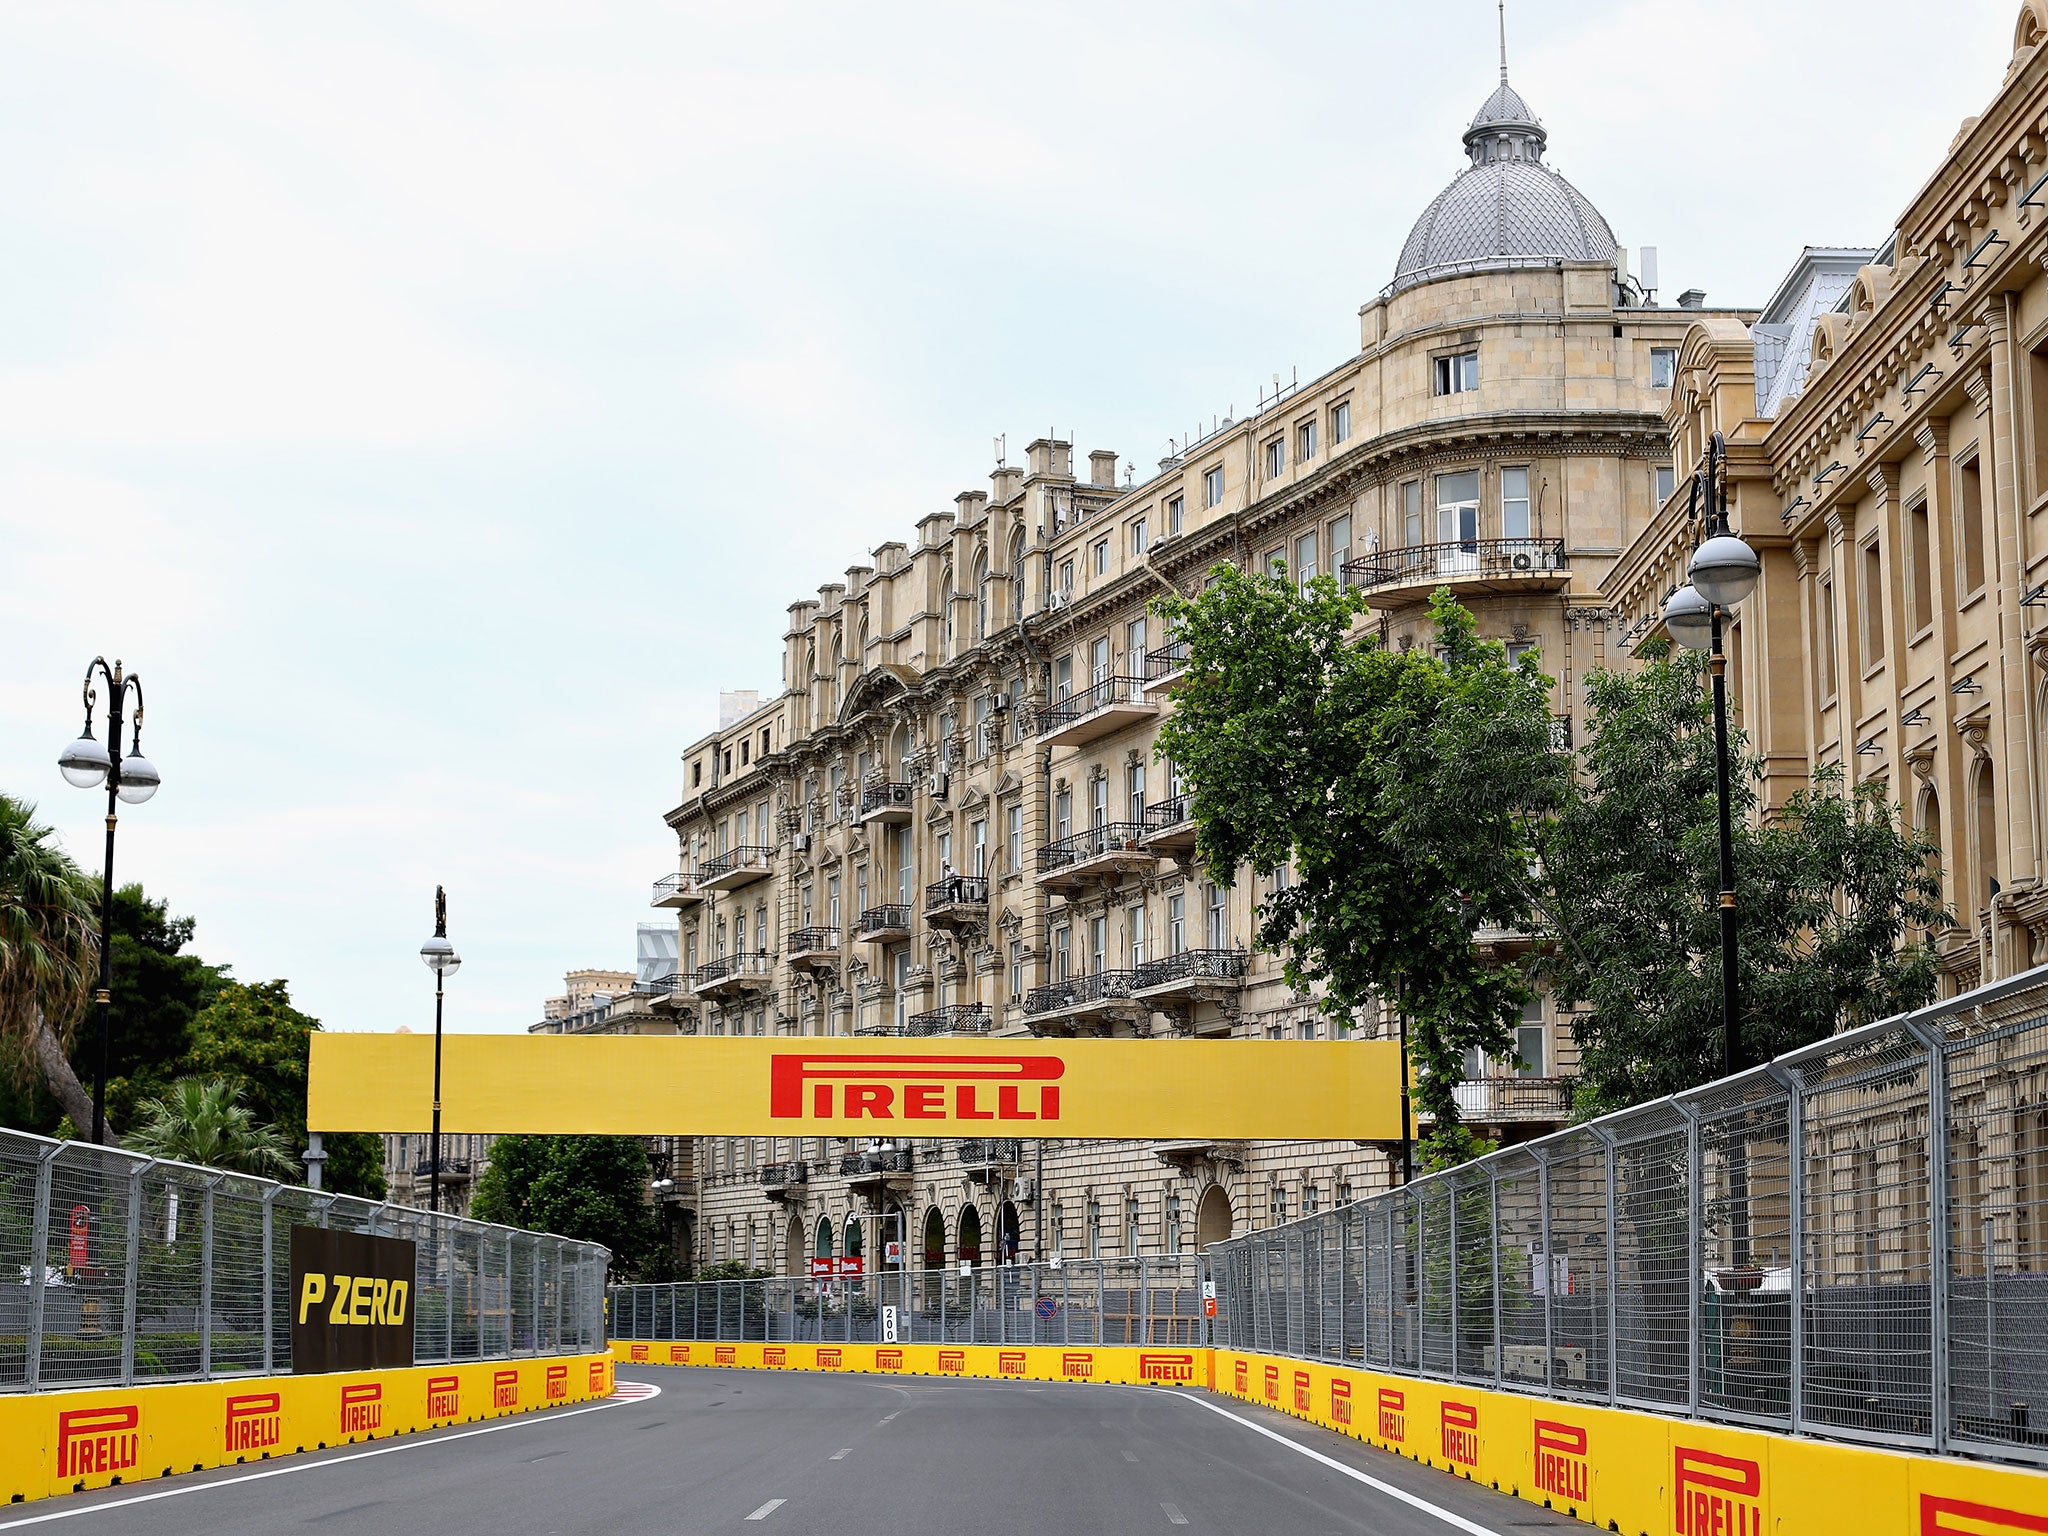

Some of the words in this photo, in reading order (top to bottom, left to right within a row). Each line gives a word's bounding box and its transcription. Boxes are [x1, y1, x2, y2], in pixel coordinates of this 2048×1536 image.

[771, 1053, 1066, 1121] PIRELLI
[299, 1273, 327, 1325] P
[329, 1275, 409, 1326] ZERO
[1206, 1300, 1214, 1314] F
[886, 1308, 894, 1340] 200
[715, 1347, 736, 1364] PIRELLI
[763, 1348, 786, 1365] PIRELLI
[817, 1349, 842, 1367] PIRELLI
[876, 1350, 903, 1369] PIRELLI
[939, 1351, 964, 1371] PIRELLI
[999, 1352, 1027, 1374] PIRELLI
[1063, 1353, 1092, 1376] PIRELLI
[1140, 1354, 1193, 1380] PIRELLI
[427, 1376, 459, 1419] PIRELLI
[494, 1370, 518, 1408] PIRELLI
[546, 1366, 567, 1399] PIRELLI
[340, 1383, 382, 1433] PIRELLI
[1332, 1379, 1351, 1424] PIRELLI
[1379, 1388, 1404, 1442] PIRELLI
[225, 1393, 280, 1452] PIRELLI
[1441, 1401, 1477, 1466] PIRELLI
[57, 1405, 139, 1478] PIRELLI
[1534, 1419, 1587, 1502] PIRELLI
